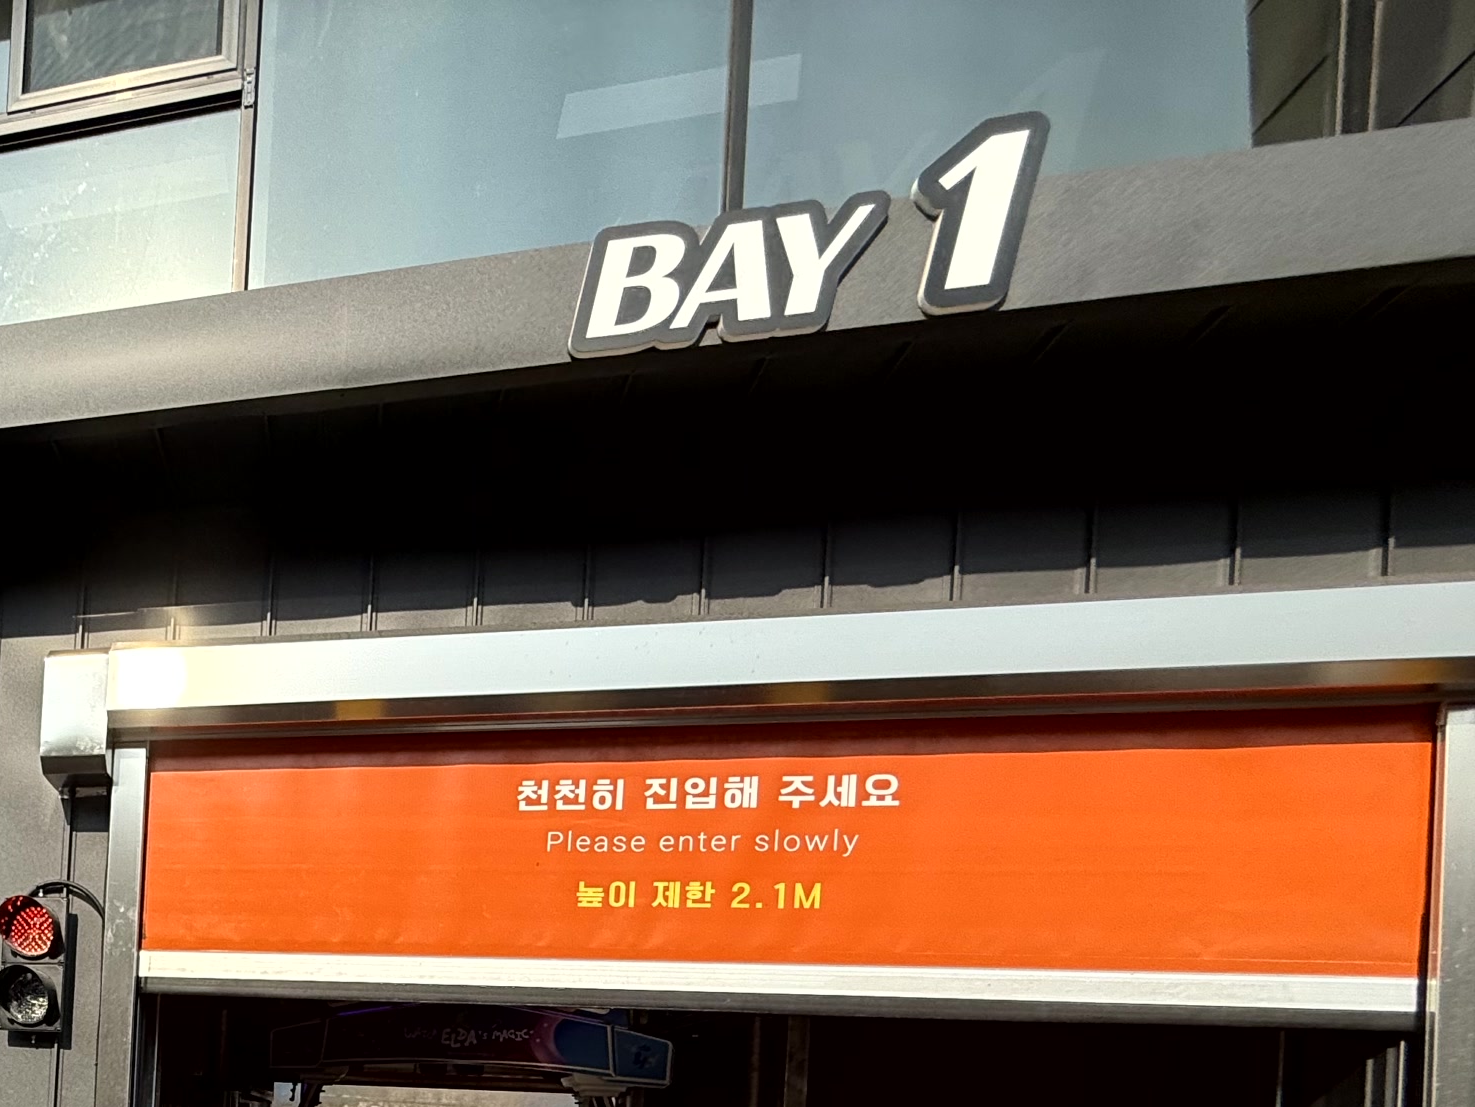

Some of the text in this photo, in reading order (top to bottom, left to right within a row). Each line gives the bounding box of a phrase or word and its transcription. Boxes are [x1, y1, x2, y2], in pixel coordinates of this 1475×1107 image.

[585, 130, 1030, 338] BAY 1
[516, 773, 902, 812] 천천히 진입해 주세요
[546, 829, 860, 857] Please enter slowly
[576, 881, 823, 910] 높이 제한 2.1M
[492, 1028, 529, 1042] MAGIC
